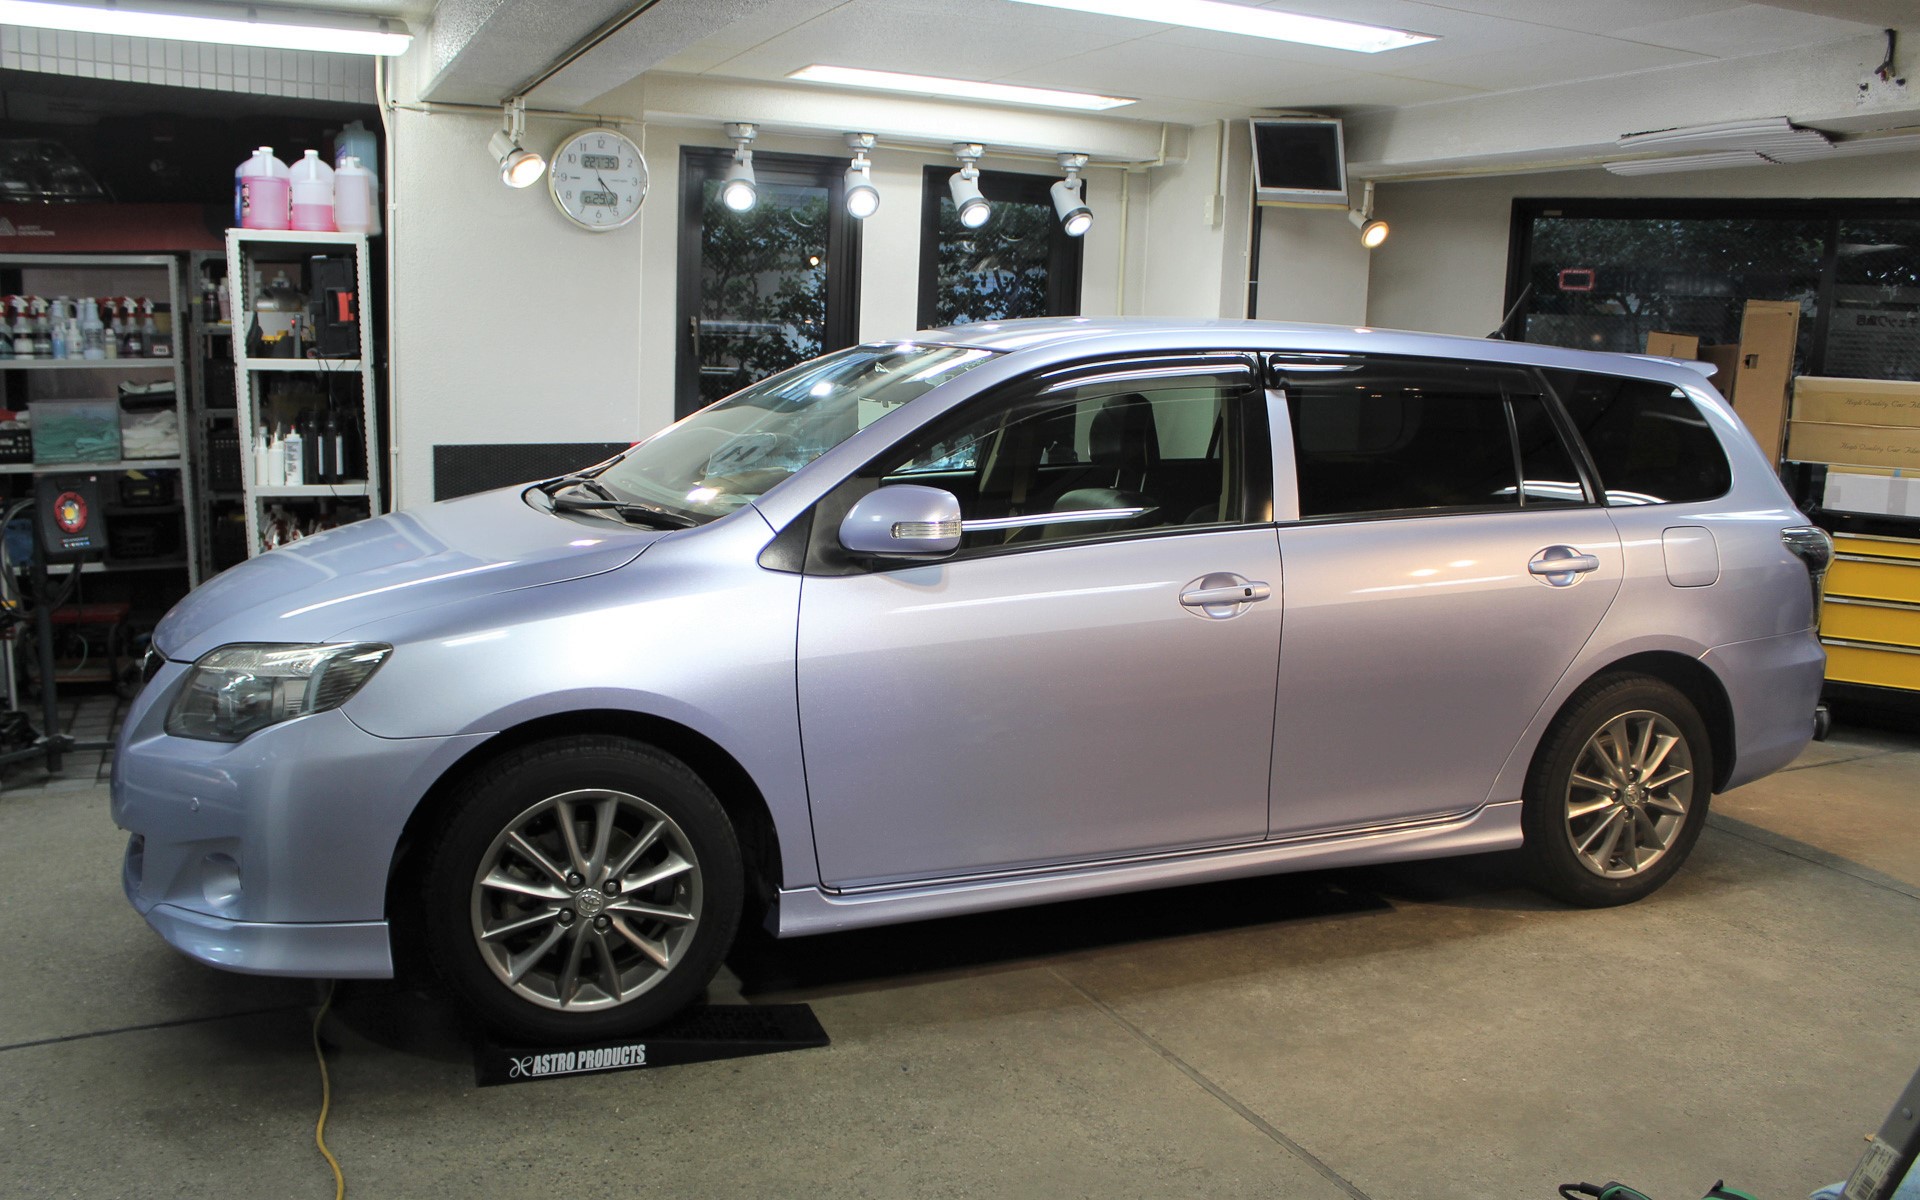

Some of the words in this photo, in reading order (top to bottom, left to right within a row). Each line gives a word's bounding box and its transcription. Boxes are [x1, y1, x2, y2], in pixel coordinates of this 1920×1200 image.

[580, 143, 586, 152] 11
[598, 140, 605, 149] 12
[568, 154, 576, 163] 10
[627, 159, 633, 168] 2
[560, 172, 568, 182] 9
[632, 177, 638, 187] 3
[566, 190, 572, 199] 8
[626, 195, 632, 204] 4
[596, 210, 602, 218] 6
[613, 207, 619, 216] 5
[1891, 400, 1906, 408] Car
[1886, 445, 1901, 453] Car
[532, 1051, 575, 1074] ASTRO
[577, 1044, 646, 1069] PRODUCTS
